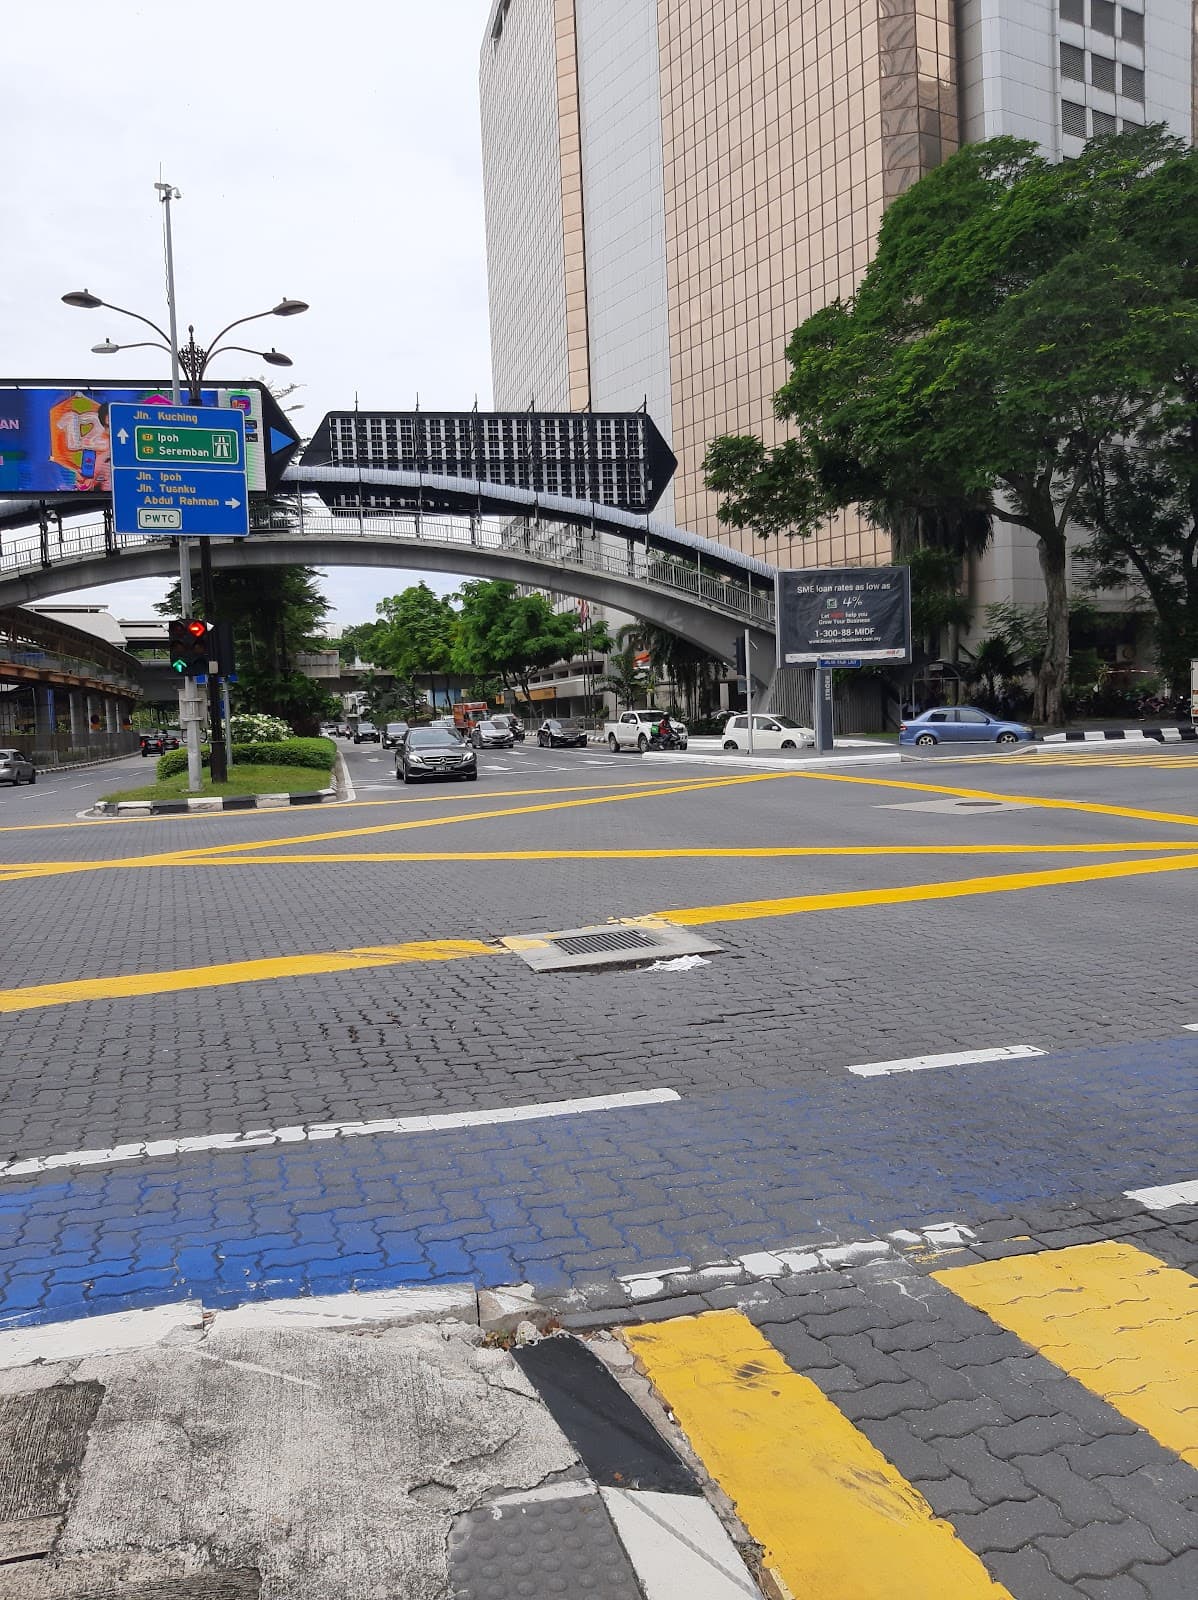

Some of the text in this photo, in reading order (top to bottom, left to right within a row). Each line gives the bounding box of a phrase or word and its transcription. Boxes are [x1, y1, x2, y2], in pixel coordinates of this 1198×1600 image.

[133, 411, 198, 424] Jln. Kuching
[158, 433, 179, 443] Ipoh
[159, 446, 210, 457] Seremban
[136, 472, 182, 483] Jln. Ipoh
[136, 484, 196, 494] Jln. Tuanku
[144, 496, 219, 506] Abdul Rahman
[144, 515, 175, 523] PWTC
[797, 586, 815, 594] SME
[816, 584, 833, 593] loan
[834, 584, 854, 592] rates
[866, 582, 880, 590] low
[843, 595, 863, 608] 4%
[845, 611, 857, 619] help
[815, 628, 876, 637] 1-300-88-MIDF
